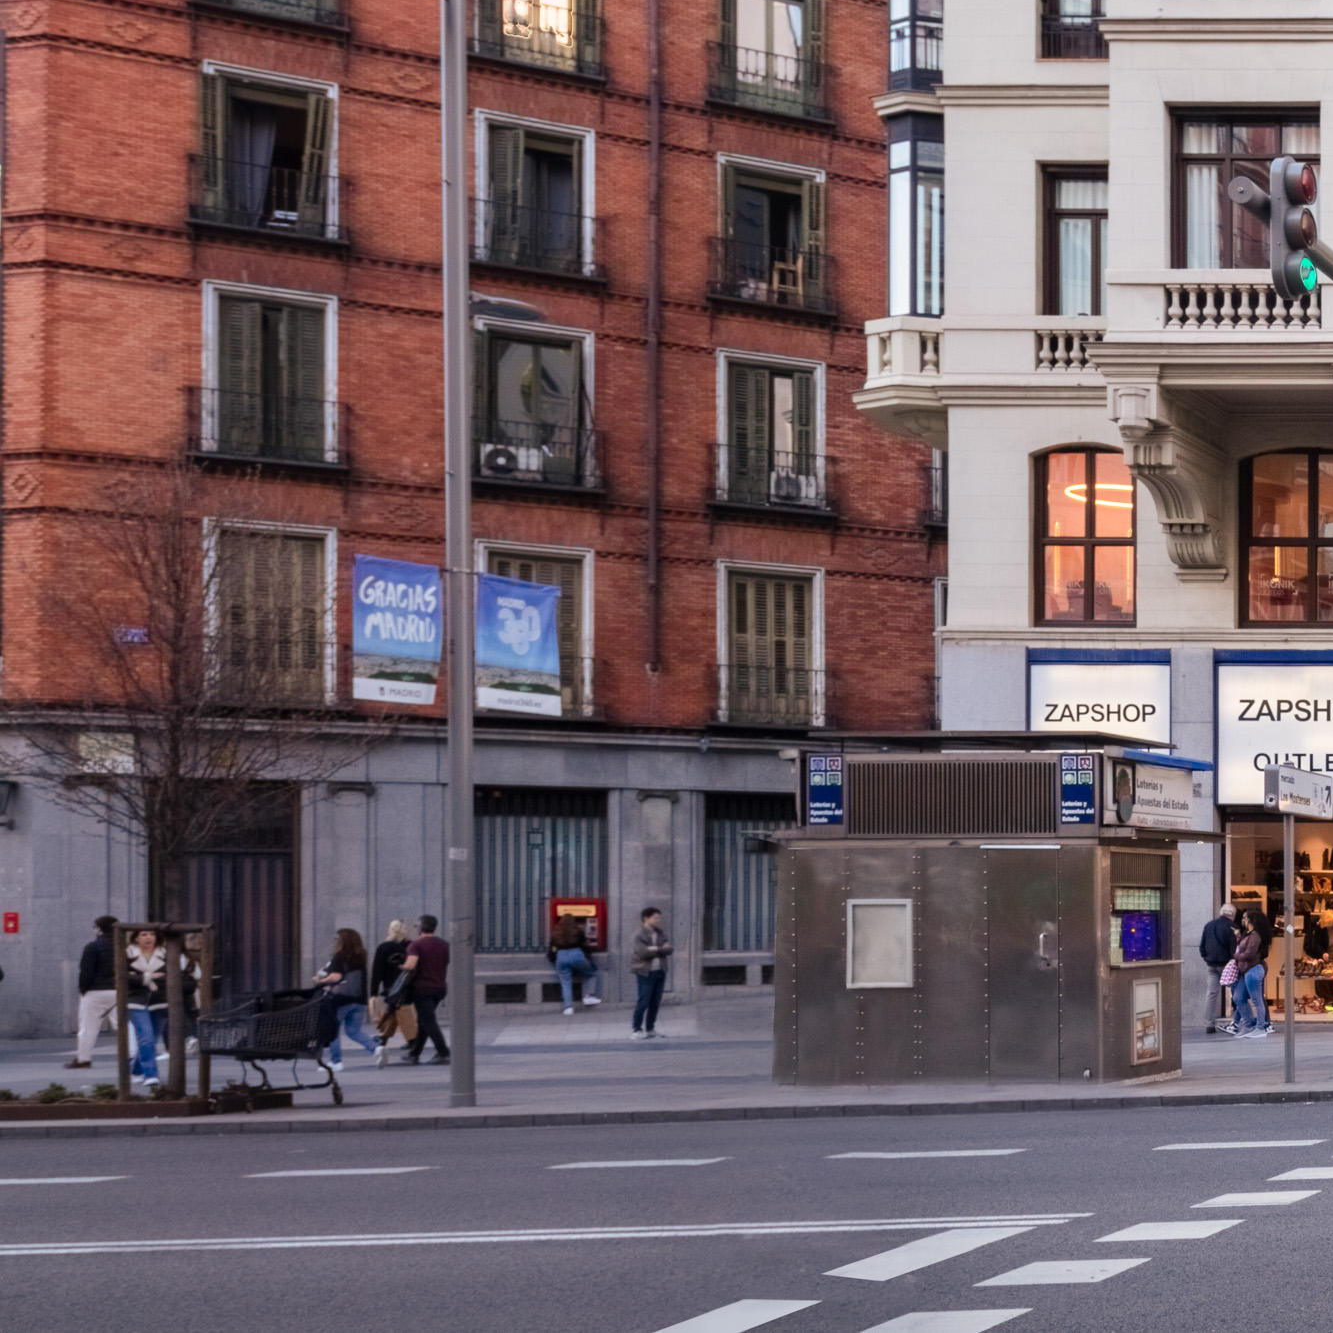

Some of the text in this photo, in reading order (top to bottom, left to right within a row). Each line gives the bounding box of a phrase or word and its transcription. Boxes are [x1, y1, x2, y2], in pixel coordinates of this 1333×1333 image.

[359, 575, 437, 613] GRACIAS
[364, 612, 436, 643] MADRID
[388, 687, 422, 698] MADRID
[1044, 703, 1156, 722] ZAPSHOP
[1172, 800, 1190, 810] Estado
